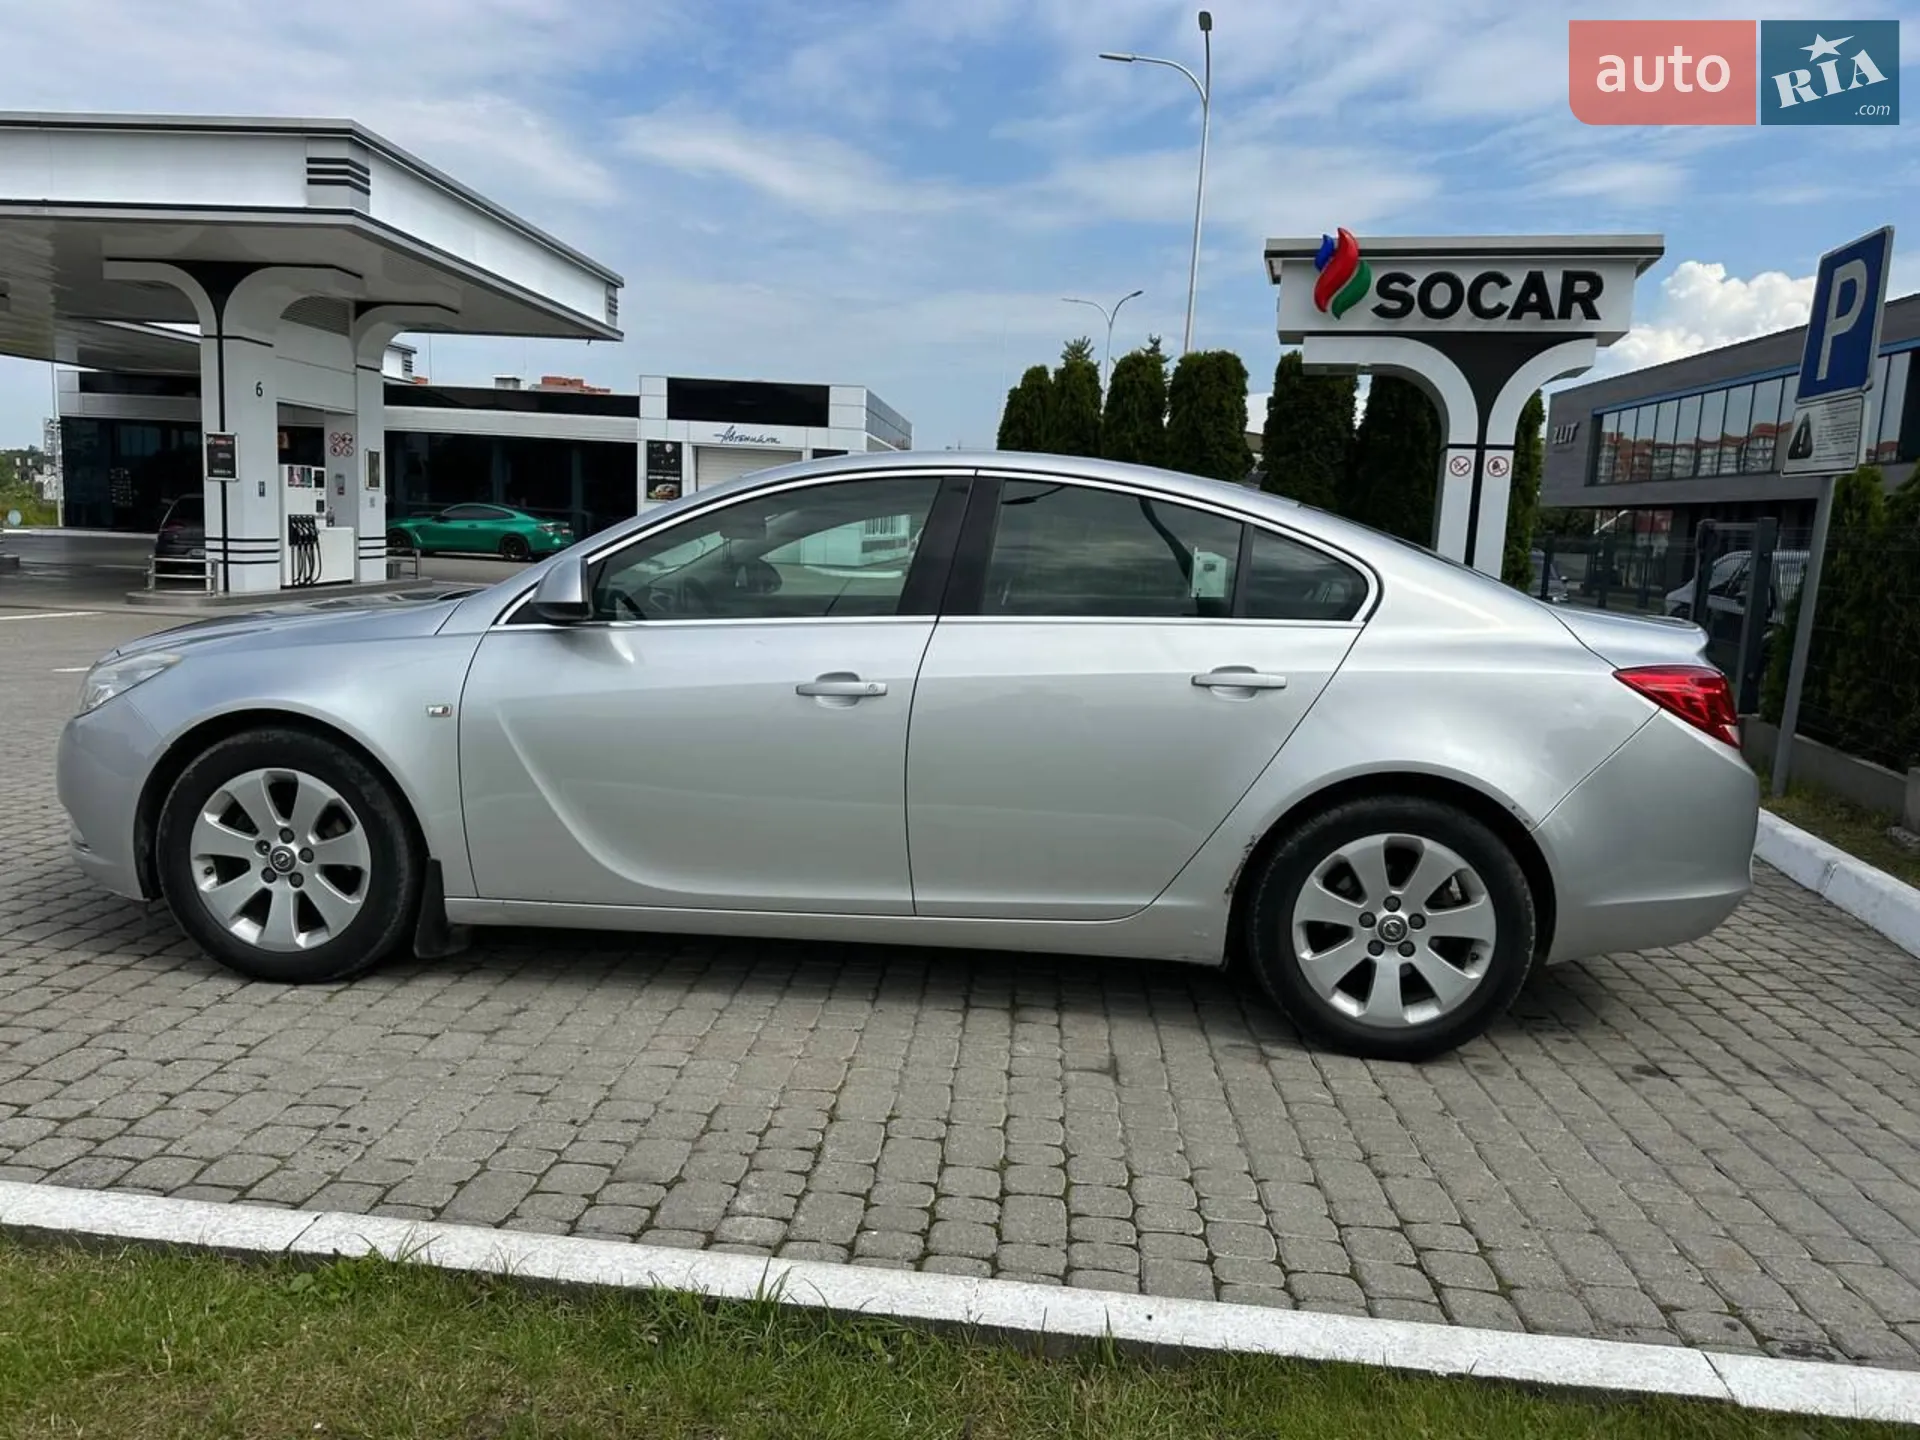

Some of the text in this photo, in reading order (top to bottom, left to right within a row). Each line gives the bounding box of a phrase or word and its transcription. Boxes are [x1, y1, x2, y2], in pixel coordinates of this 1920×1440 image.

[1370, 270, 1604, 320] SOCAR
[1815, 258, 1867, 381] P
[255, 380, 264, 397] 6
